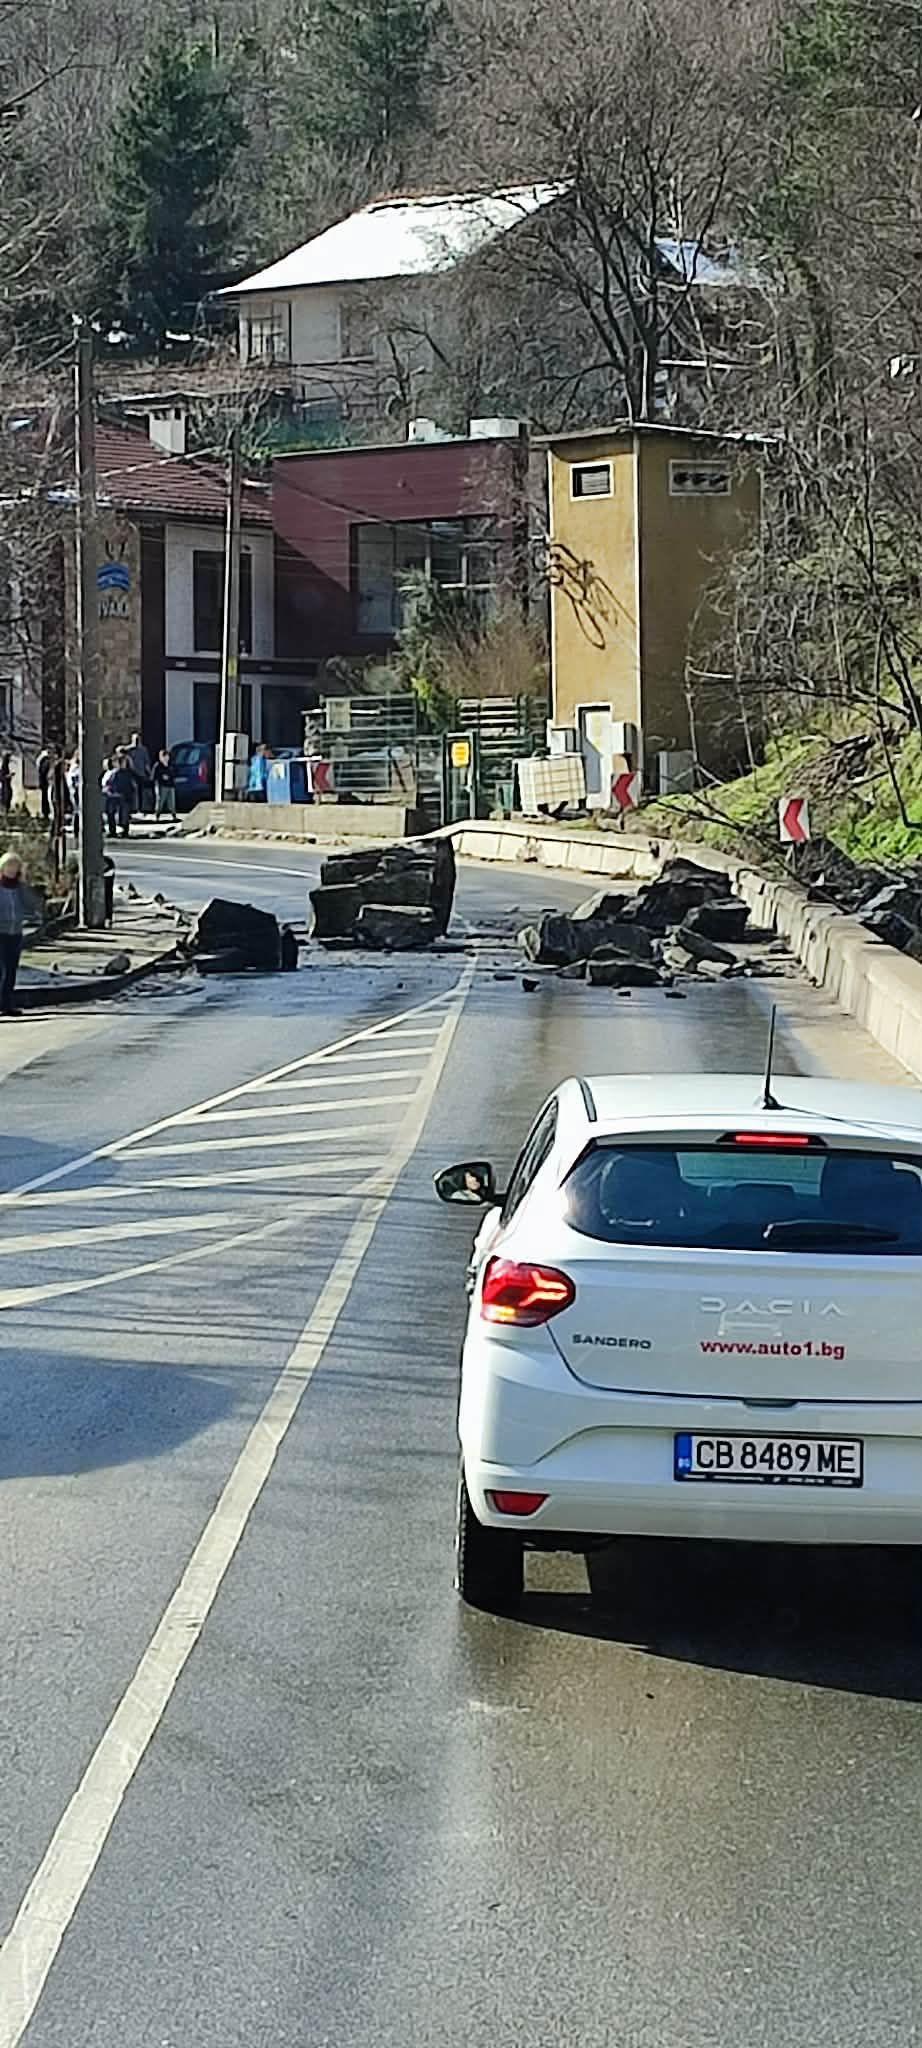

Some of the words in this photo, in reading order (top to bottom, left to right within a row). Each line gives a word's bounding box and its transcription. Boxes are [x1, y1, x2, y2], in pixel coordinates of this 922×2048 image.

[700, 1296, 848, 1316] DACIA
[572, 1333, 652, 1350] SANDERO
[700, 1340, 845, 1360] www.auto1.bg
[696, 1440, 734, 1469] CB
[740, 1441, 811, 1473] 8489
[817, 1443, 856, 1474] ME
